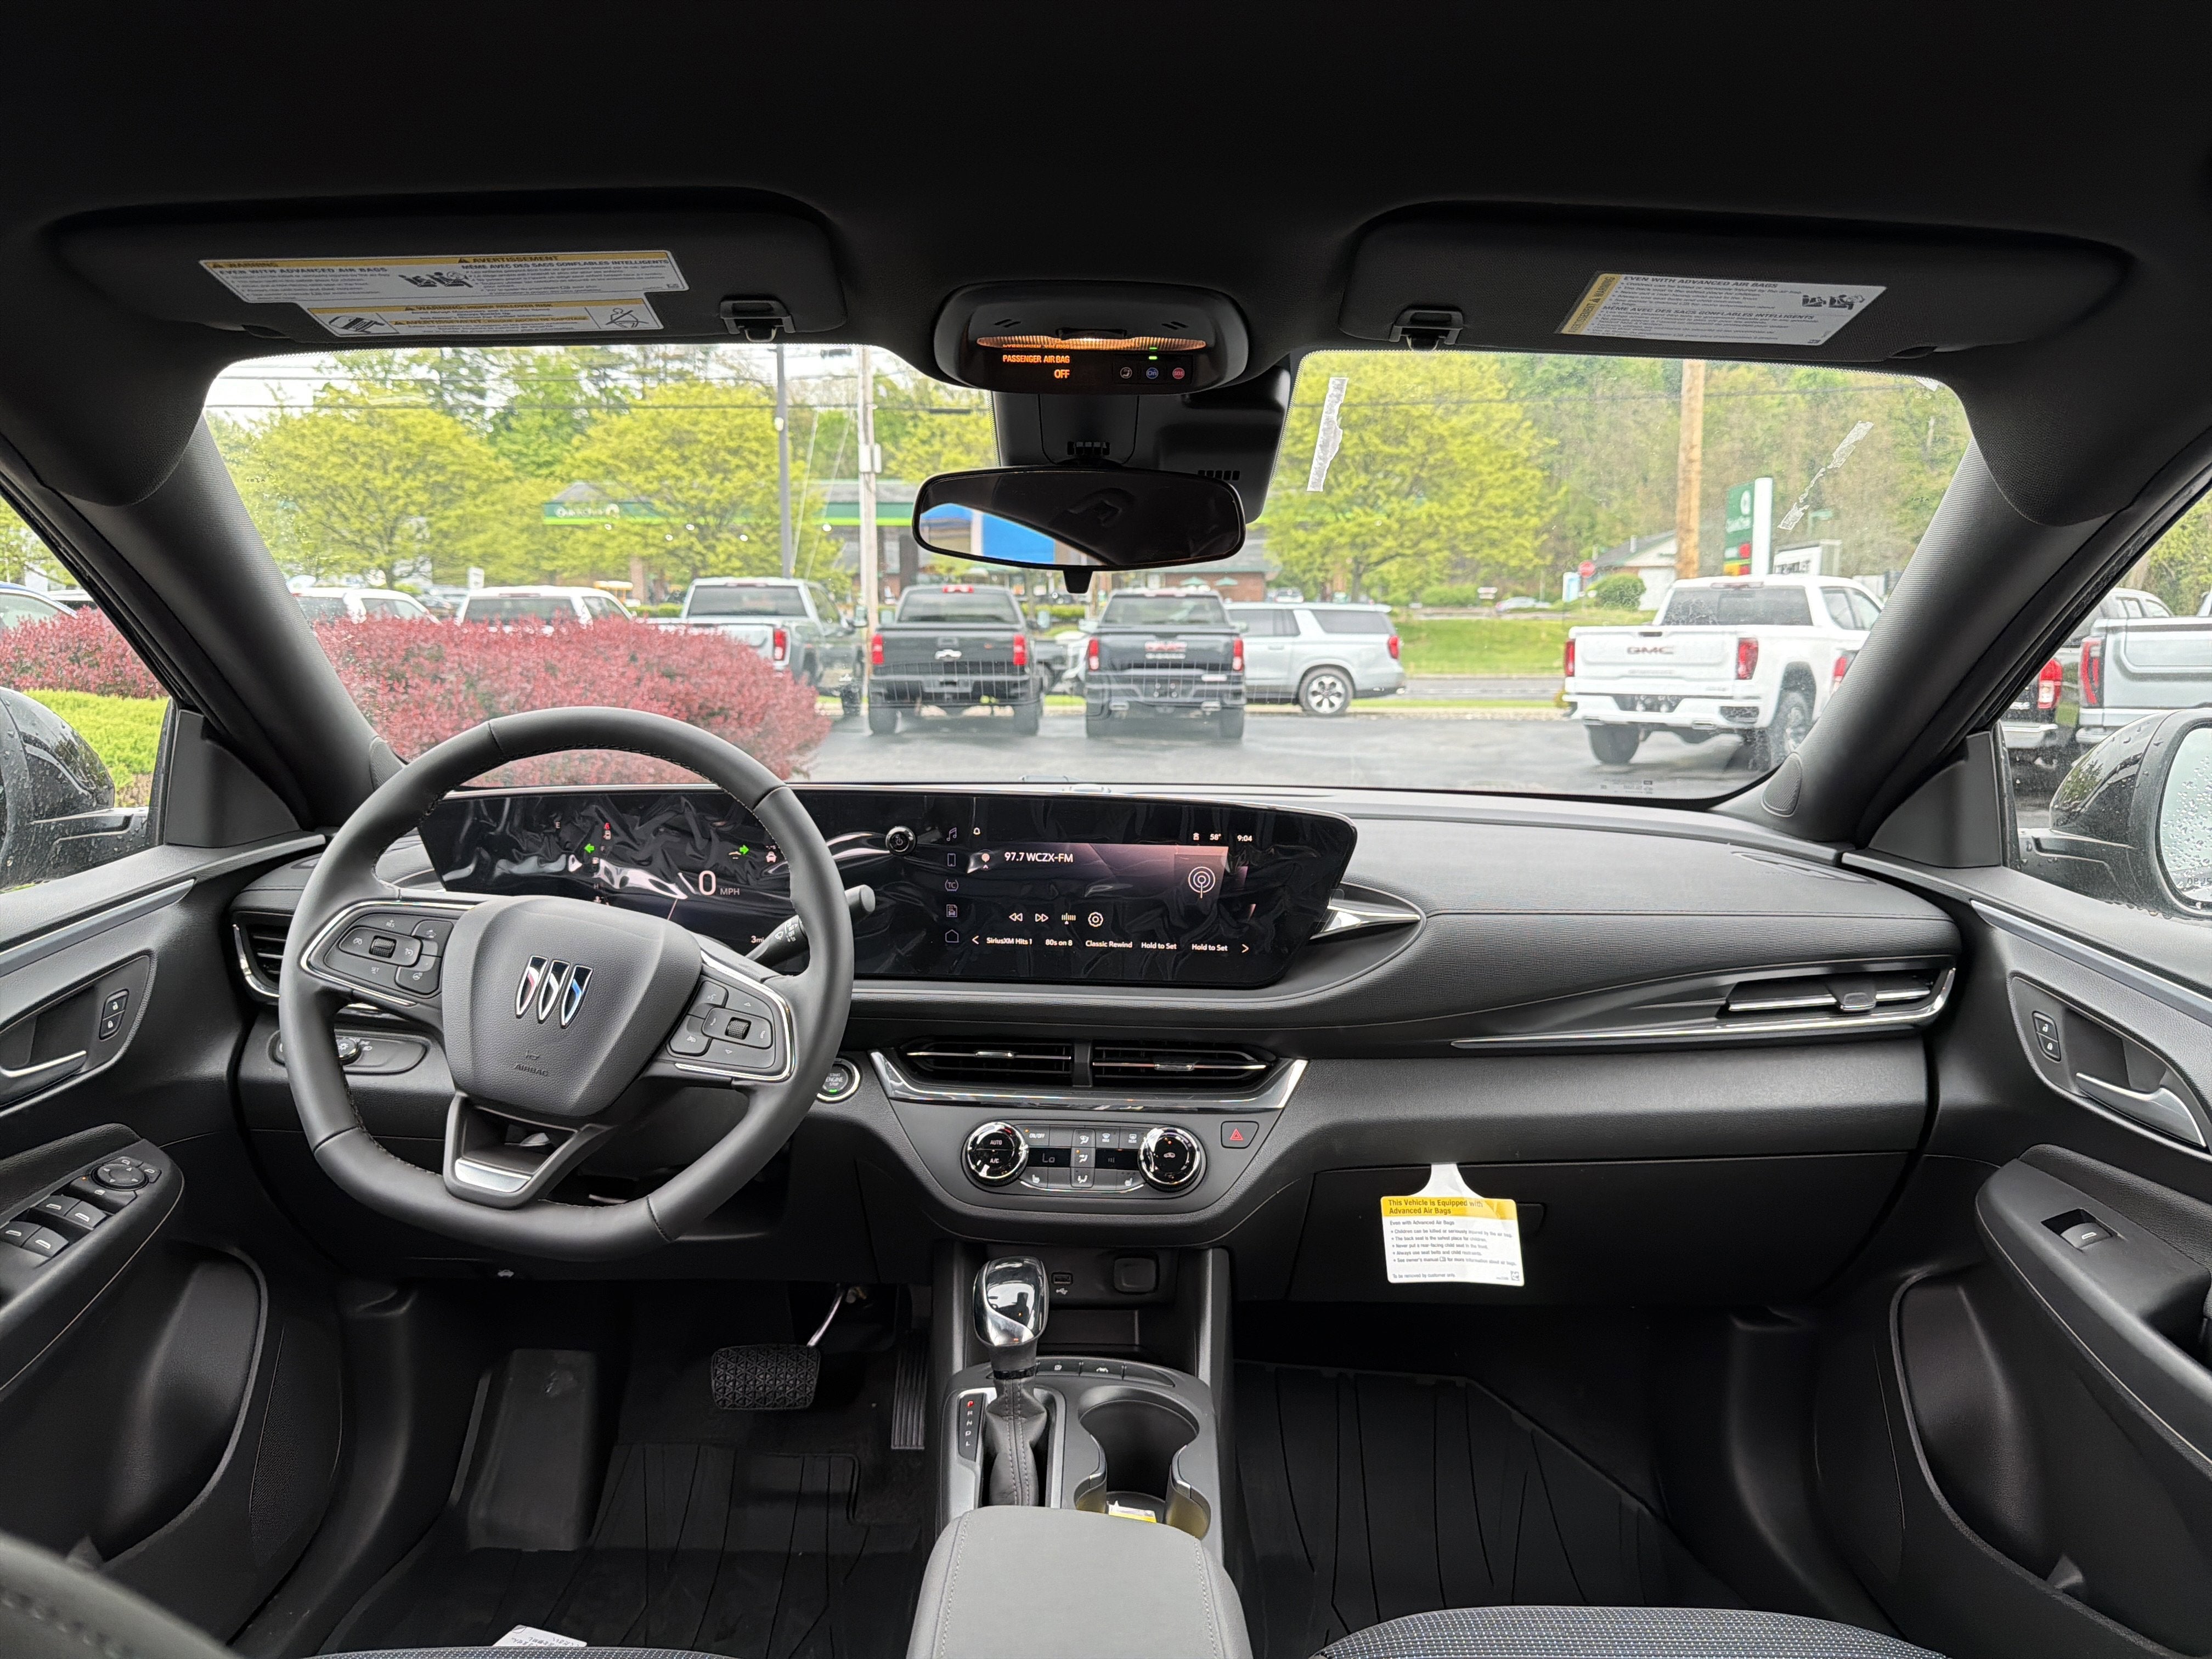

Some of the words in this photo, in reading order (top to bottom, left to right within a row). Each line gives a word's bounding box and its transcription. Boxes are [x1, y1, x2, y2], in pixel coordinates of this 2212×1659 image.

[1003, 354, 1042, 363] PASSENGER
[1043, 355, 1055, 363] AIR
[1056, 355, 1070, 363] BAG
[1054, 369, 1070, 379] OFF
[1627, 646, 1674, 654] GMC
[1005, 851, 1025, 861] 97.7
[1026, 852, 1074, 862] WCZX-FM
[698, 870, 716, 896] 0
[515, 1064, 548, 1076] AIRBAG
[1437, 1199, 1468, 1207] Equipped
